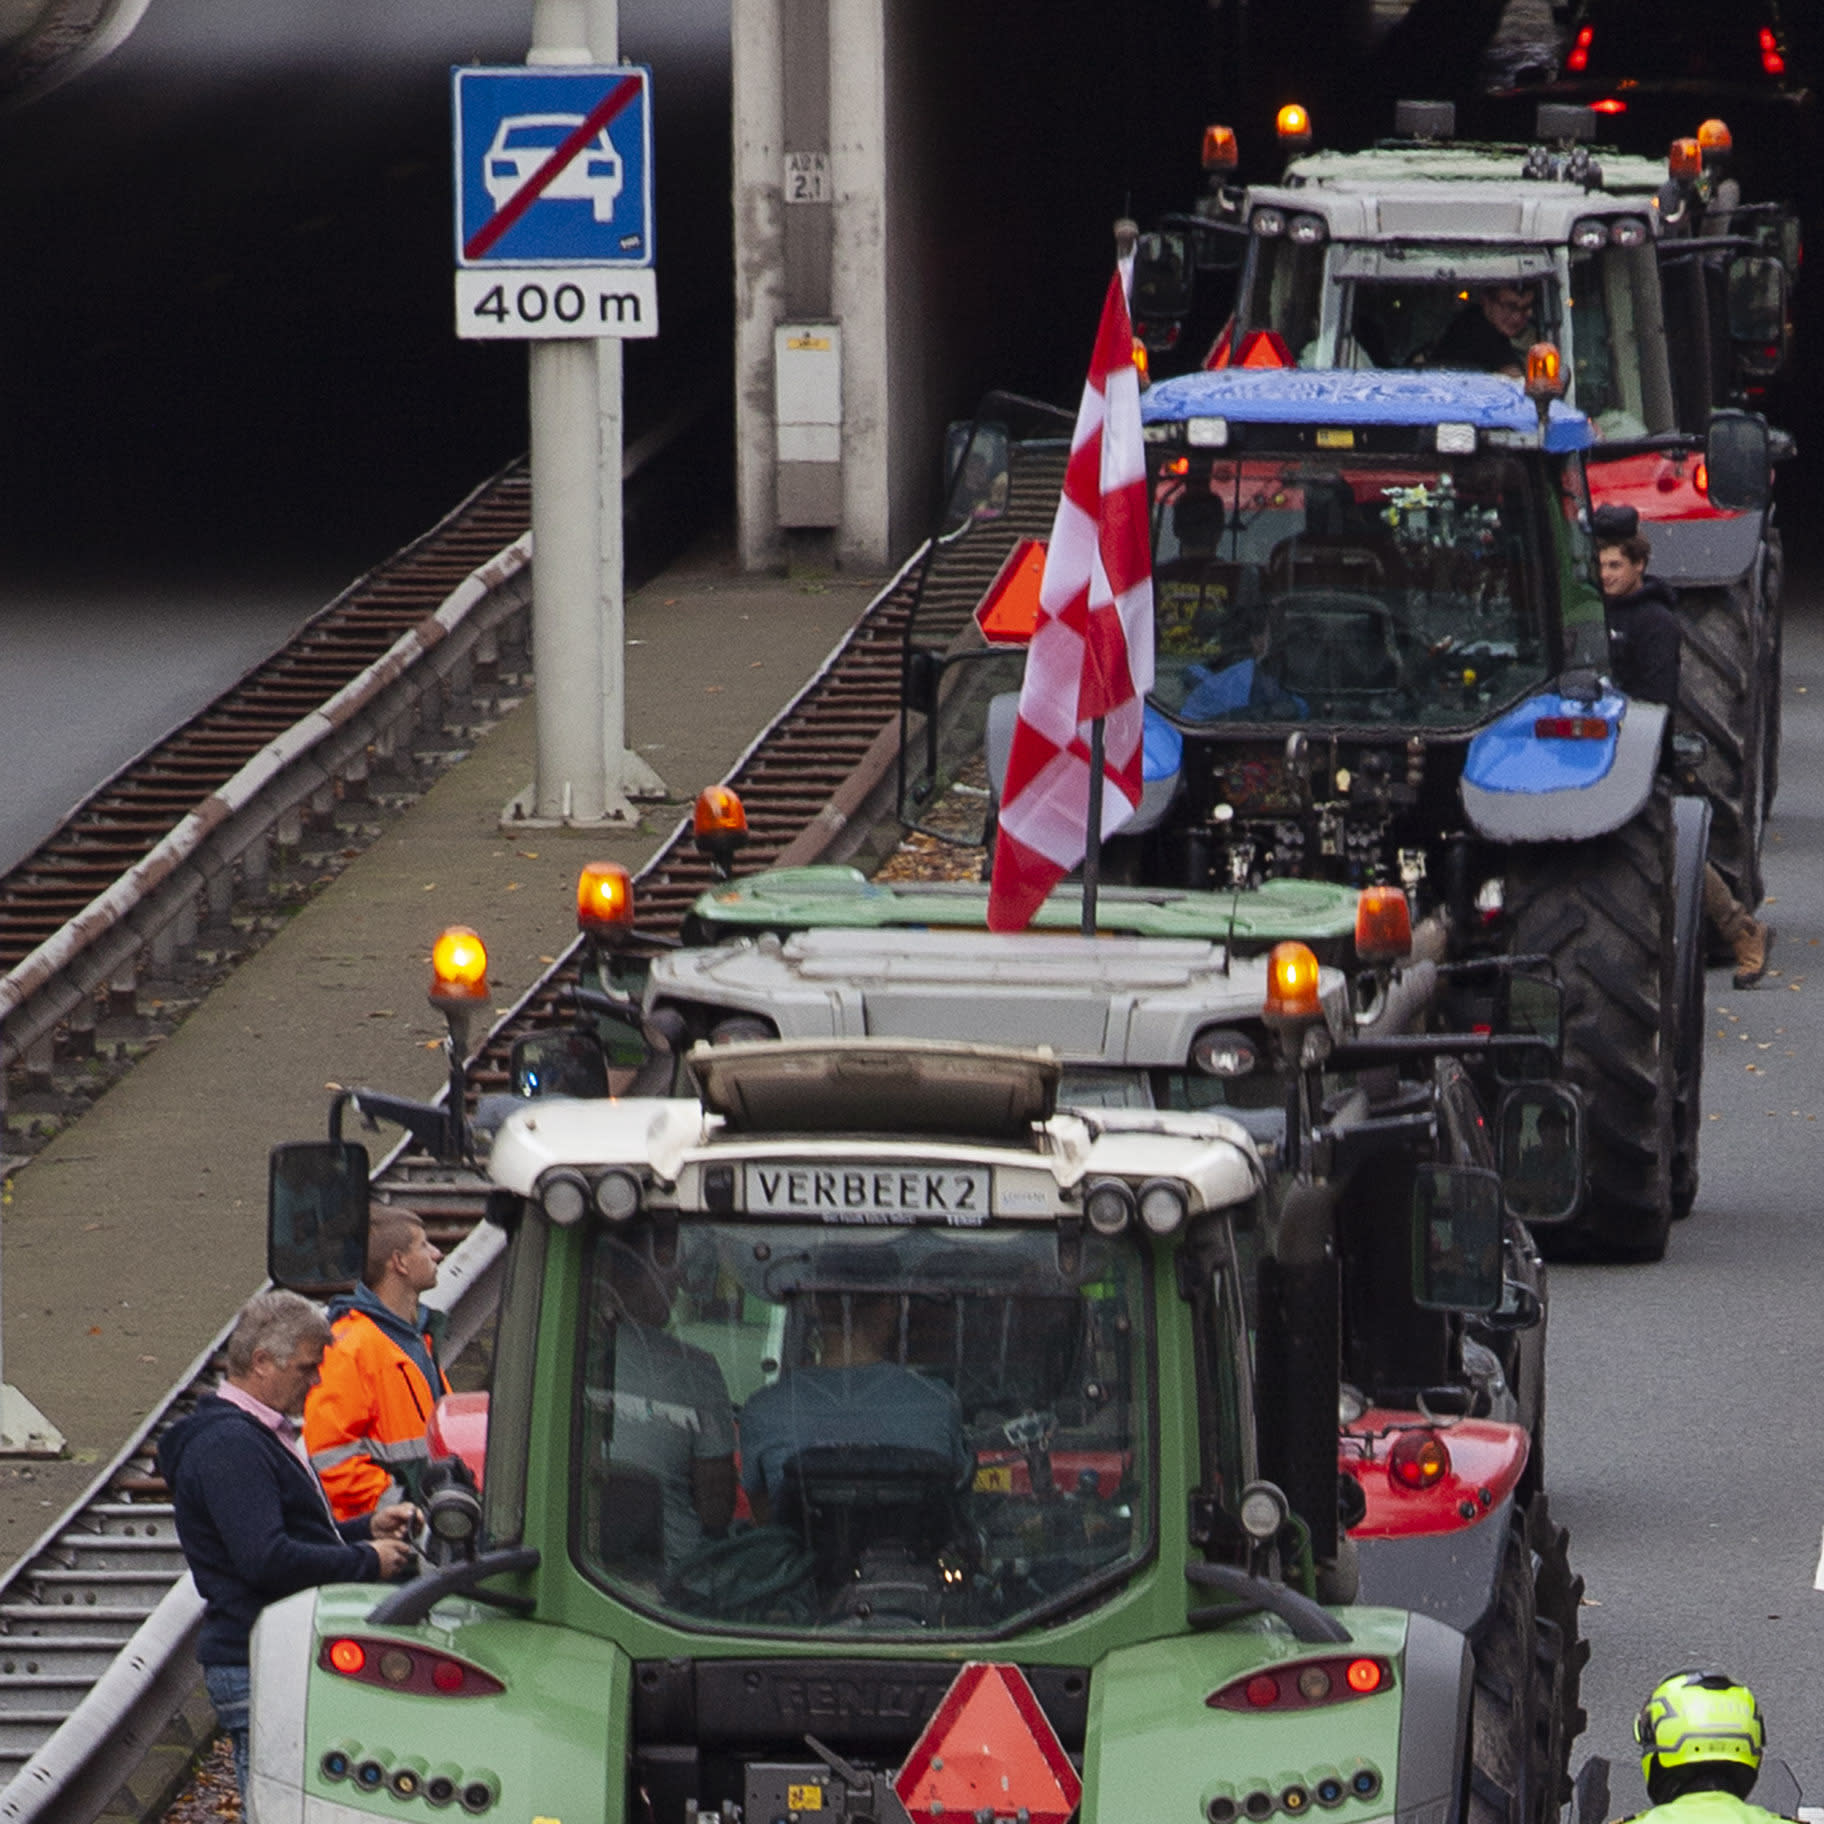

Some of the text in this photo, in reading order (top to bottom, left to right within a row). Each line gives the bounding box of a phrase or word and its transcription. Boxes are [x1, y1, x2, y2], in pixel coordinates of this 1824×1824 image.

[474, 284, 641, 323] 400 m
[758, 1172, 976, 1211] VERBEEK2
